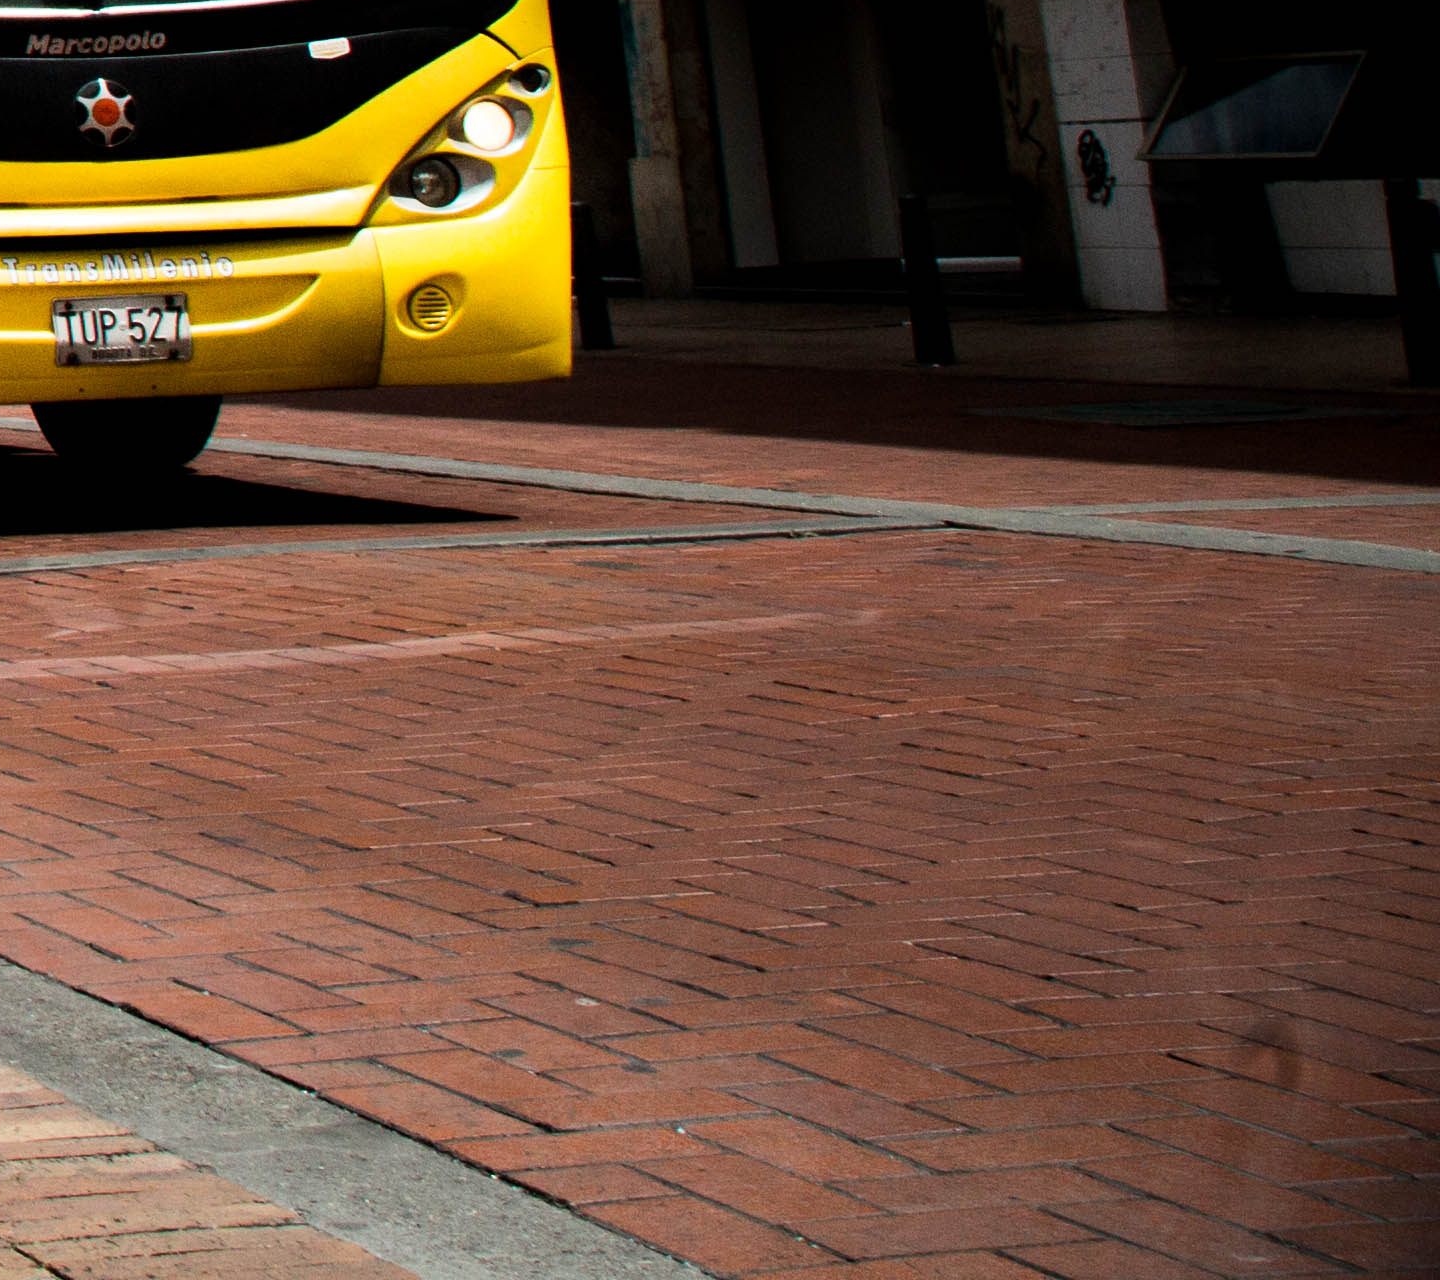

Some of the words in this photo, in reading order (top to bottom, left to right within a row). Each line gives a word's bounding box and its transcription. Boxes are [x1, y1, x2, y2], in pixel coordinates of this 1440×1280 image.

[25, 30, 167, 55] Marcopolo
[2, 251, 235, 285] TransMilenio
[58, 309, 117, 347] TUP
[127, 305, 184, 344] 527
